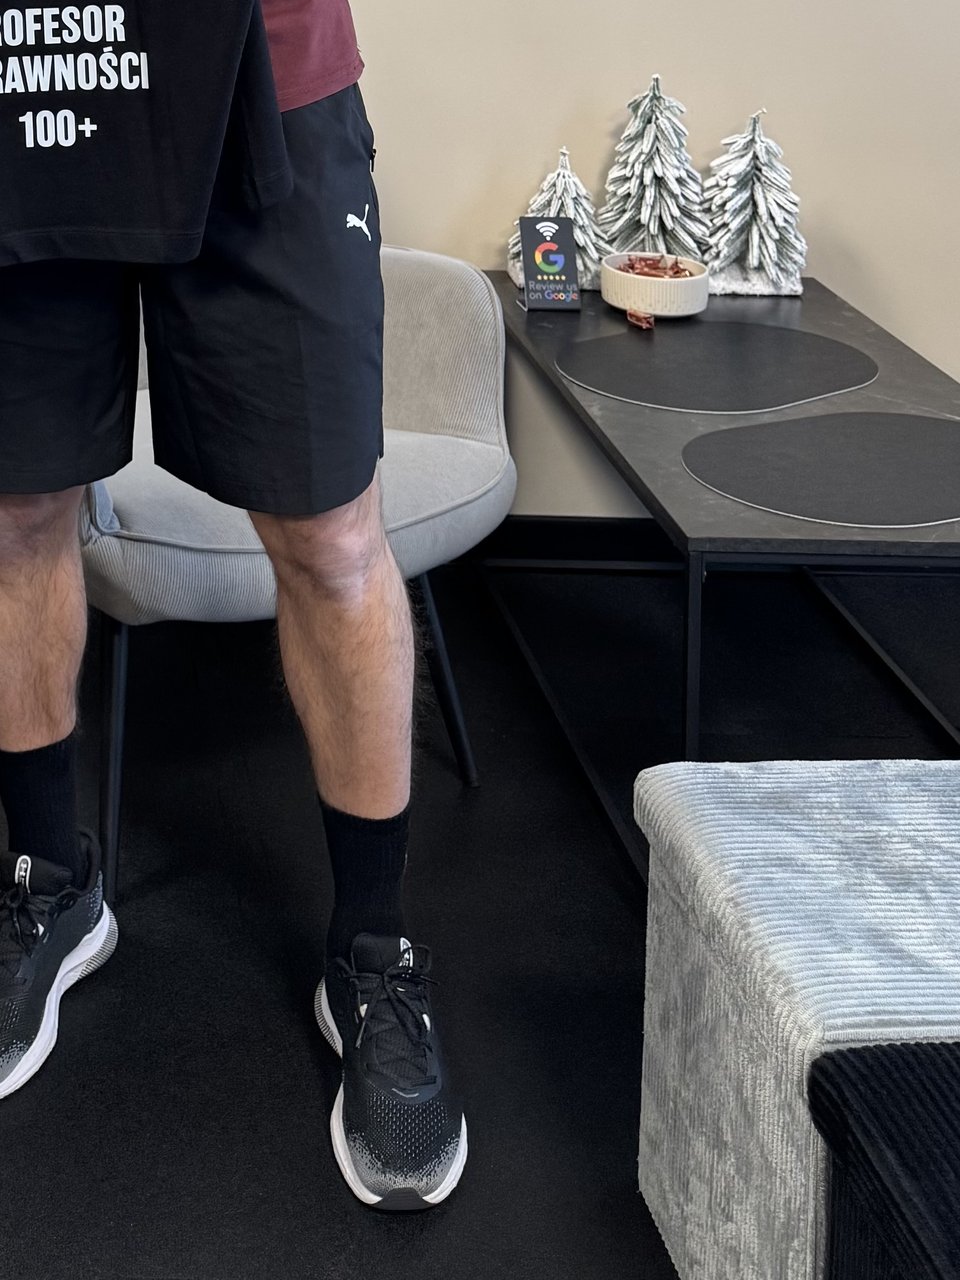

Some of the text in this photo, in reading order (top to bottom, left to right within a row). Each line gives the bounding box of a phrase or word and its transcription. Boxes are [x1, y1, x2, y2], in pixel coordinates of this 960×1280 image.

[18, 108, 98, 148] 100+
[528, 280, 578, 291] Review us
[529, 290, 577, 302] on Google
